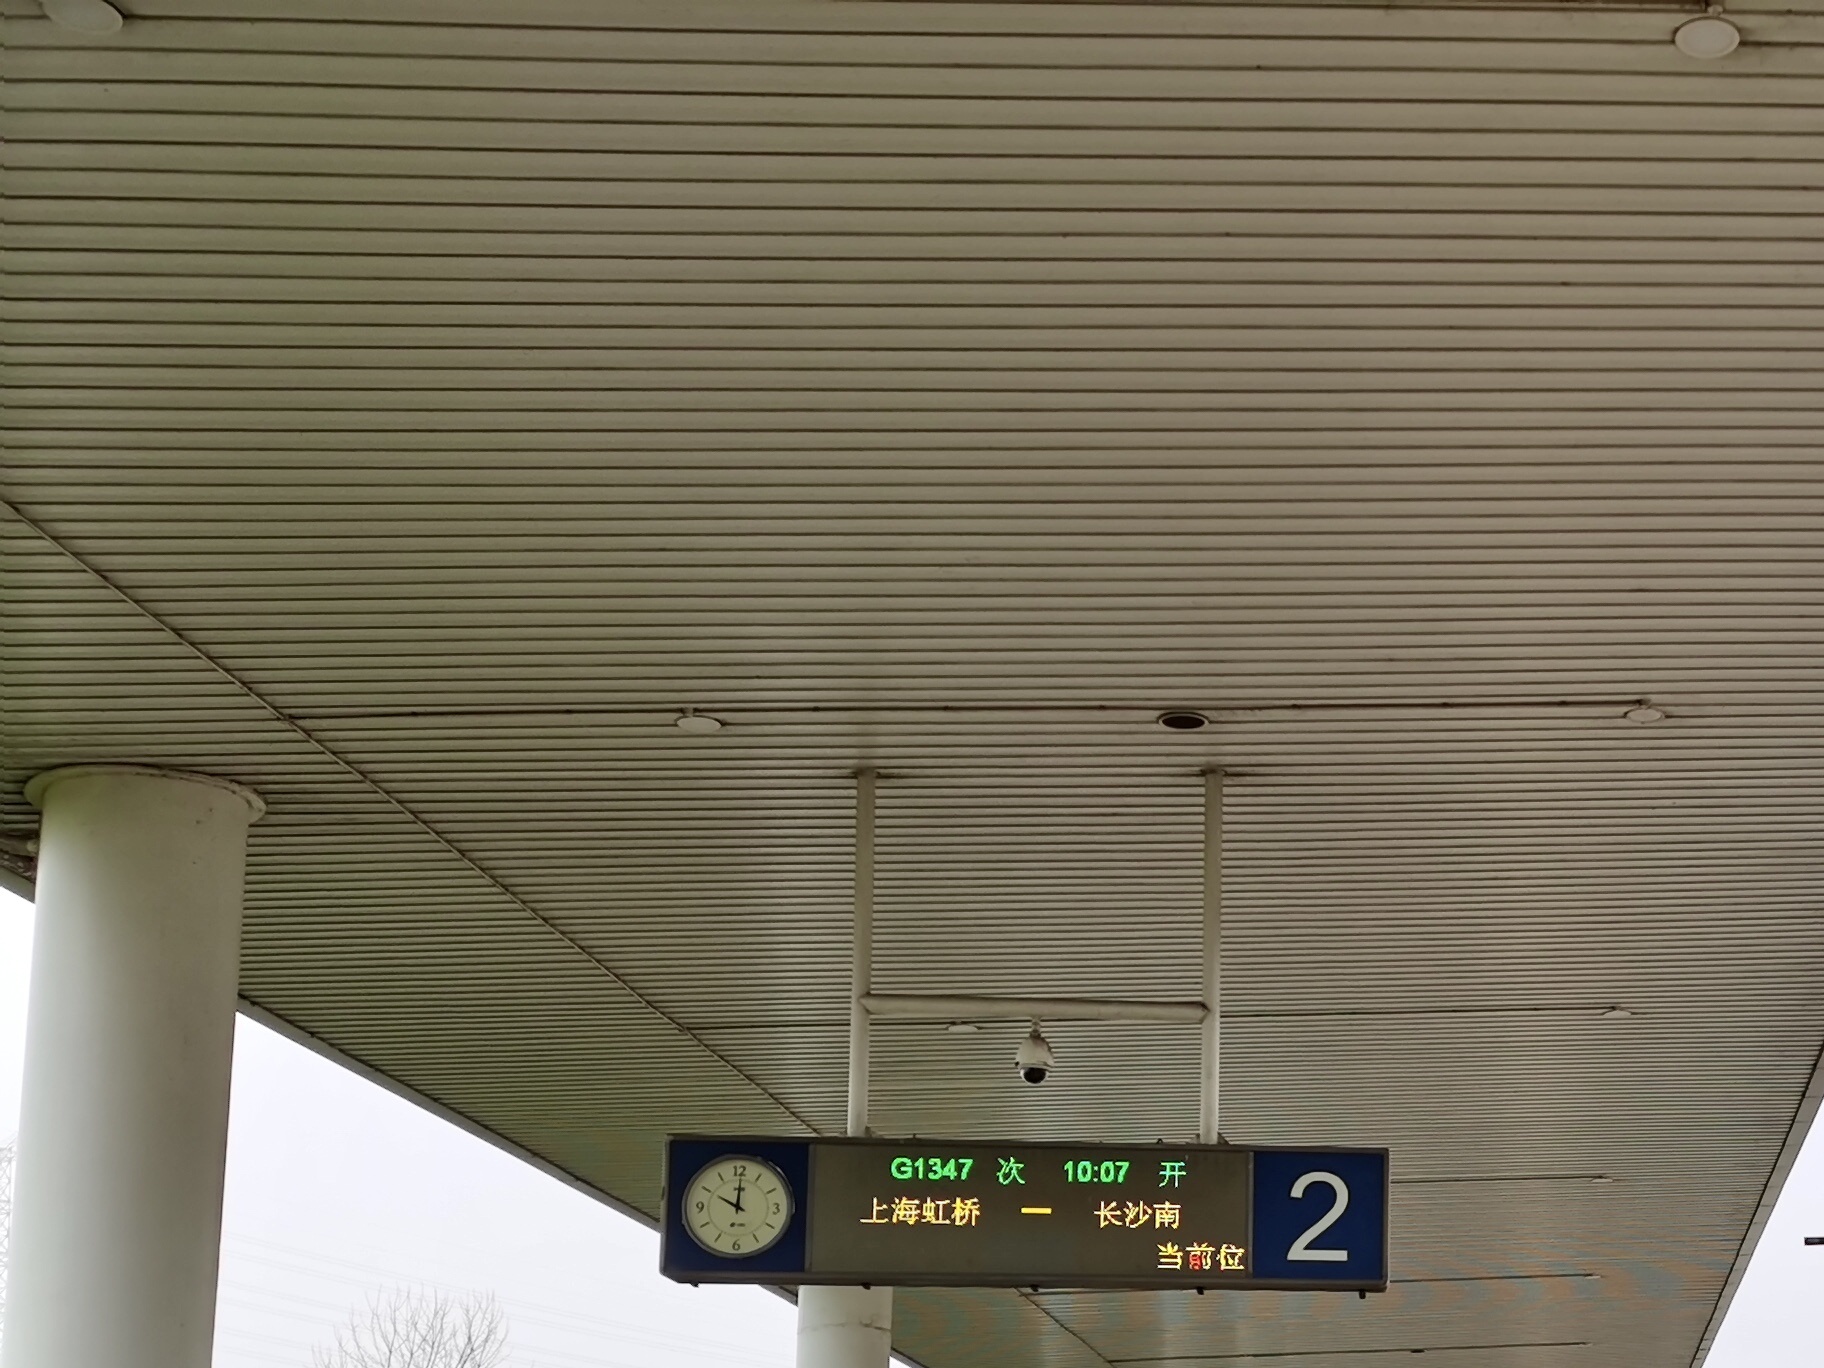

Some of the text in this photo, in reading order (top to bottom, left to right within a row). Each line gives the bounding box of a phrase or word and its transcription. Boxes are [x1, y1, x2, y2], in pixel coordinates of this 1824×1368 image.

[732, 1165, 747, 1178] 12
[889, 1155, 1188, 1189] G1347 次 10:07 开
[695, 1200, 705, 1214] 9
[771, 1202, 781, 1216] 3
[859, 1196, 982, 1228] 上海虹桥
[1093, 1199, 1183, 1230] 长沙南
[1286, 1170, 1350, 1263] 2
[731, 1238, 741, 1251] 6
[1156, 1240, 1247, 1271] 当前位
